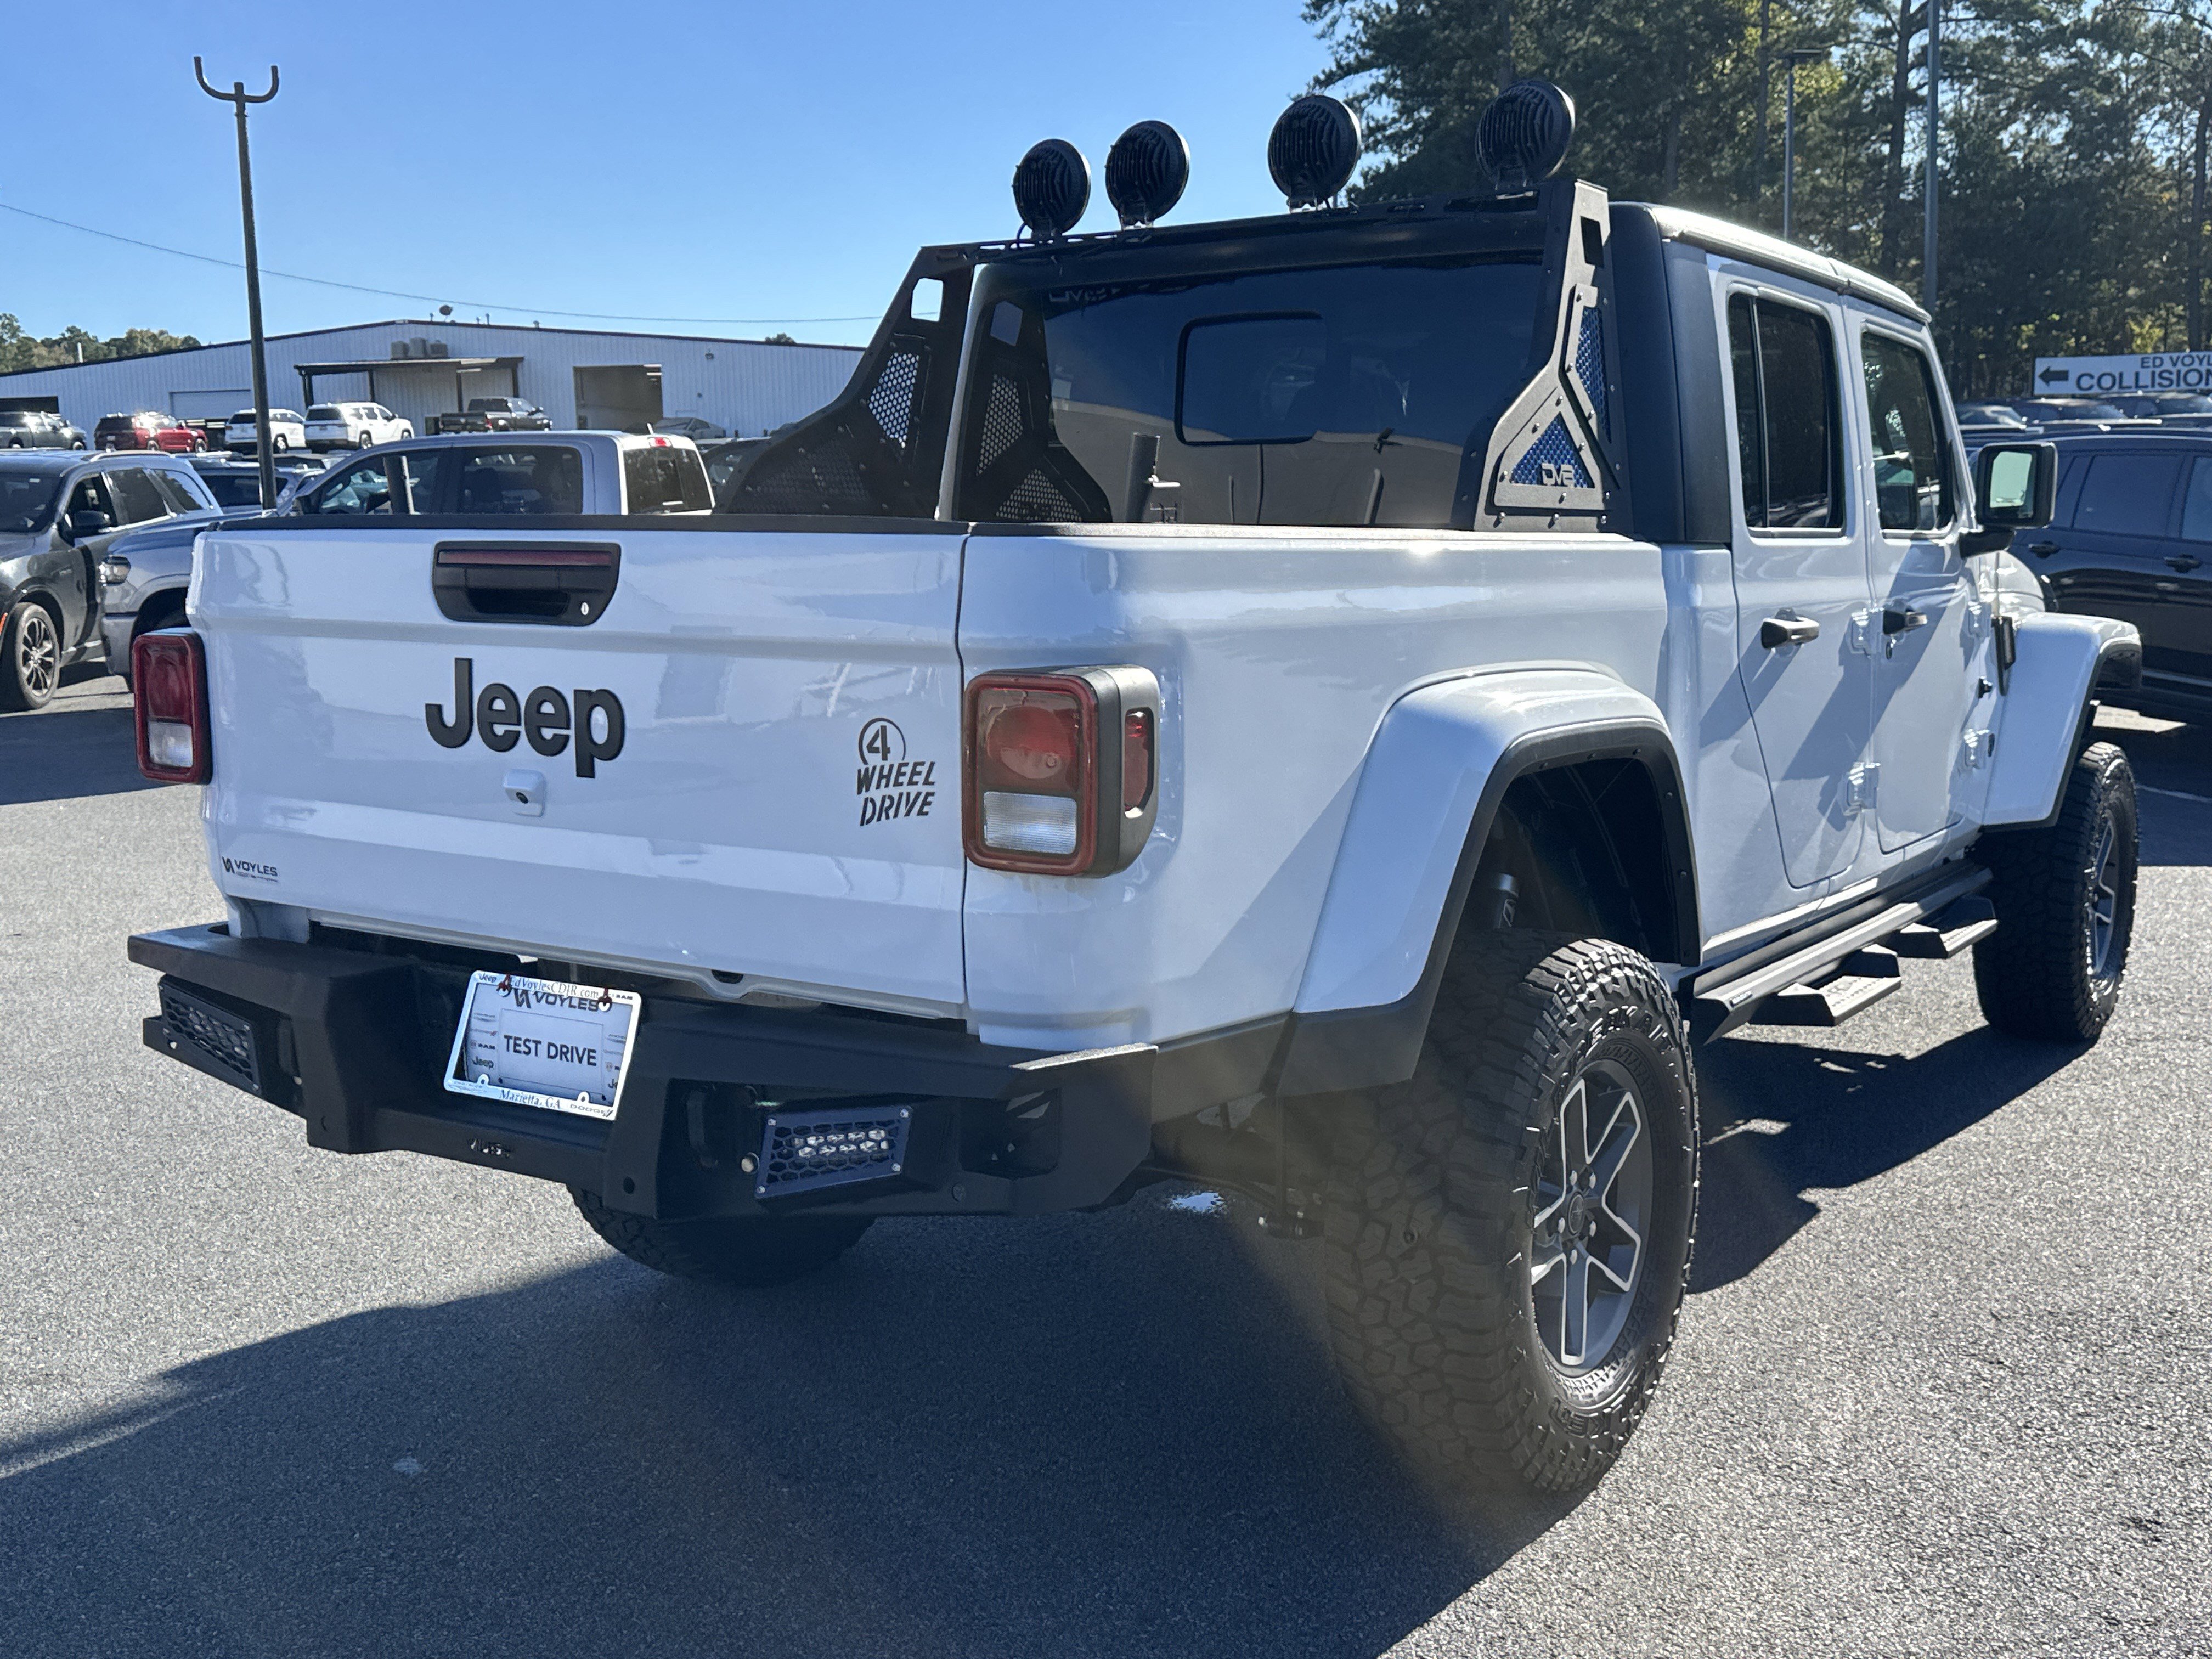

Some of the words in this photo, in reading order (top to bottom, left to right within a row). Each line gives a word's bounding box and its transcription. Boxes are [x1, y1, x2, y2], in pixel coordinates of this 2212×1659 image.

[2140, 356, 2164, 369] ED
[425, 657, 625, 778] Jeep
[866, 725, 891, 761] 4
[856, 761, 935, 795] WHEEL
[859, 791, 935, 826] DRIVE
[234, 858, 278, 877] VOYLES
[478, 972, 497, 983] Jeep
[533, 990, 599, 1012] VOYLES
[503, 1034, 542, 1058] TEST
[546, 1041, 597, 1067] DRIVE
[472, 1056, 494, 1070] Jeep
[545, 1097, 562, 1110] GA
